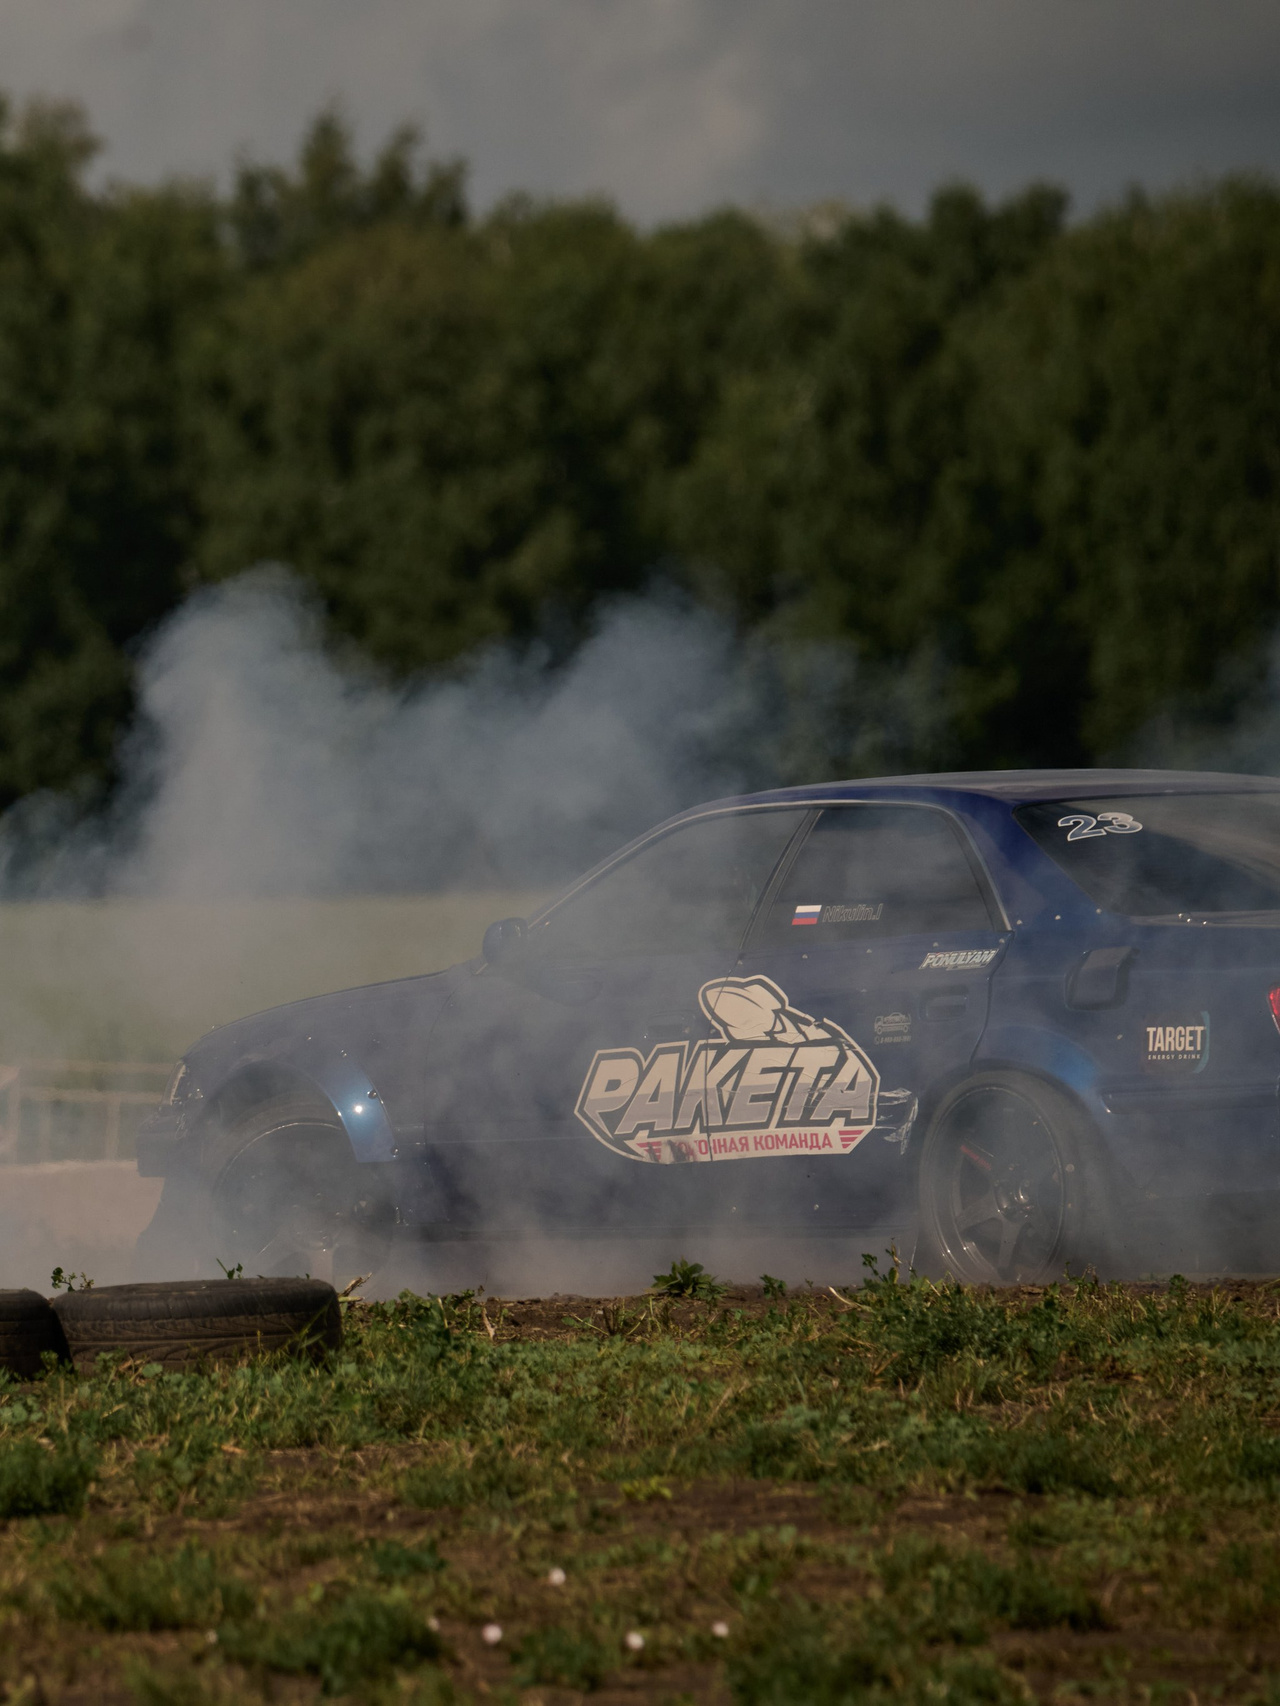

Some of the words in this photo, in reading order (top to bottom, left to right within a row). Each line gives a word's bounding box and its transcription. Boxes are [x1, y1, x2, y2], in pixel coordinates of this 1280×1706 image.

[1057, 812, 1143, 842] 23
[1146, 1025, 1205, 1052] TARGET
[754, 1132, 833, 1151] КОМАНДА
